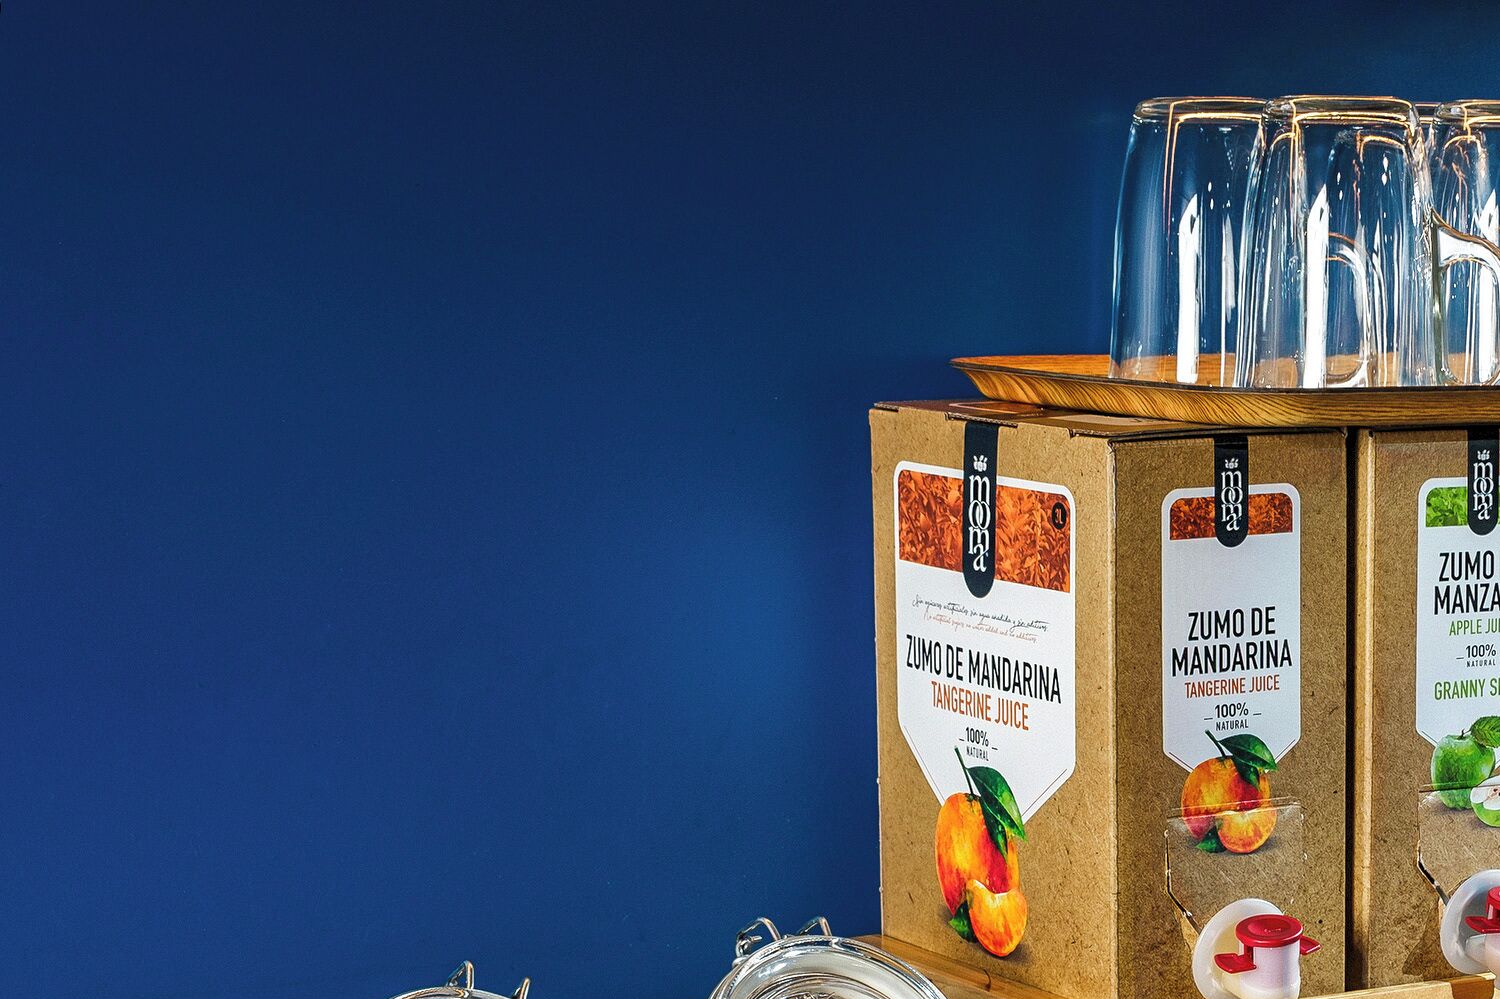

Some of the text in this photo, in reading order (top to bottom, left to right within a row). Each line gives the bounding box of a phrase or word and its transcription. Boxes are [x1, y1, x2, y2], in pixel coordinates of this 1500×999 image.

[1439, 550, 1494, 582] ZUMO
[1188, 606, 1276, 641] ZUMO DE
[1449, 618, 1482, 636] APPLE
[1171, 639, 1293, 678] MANDARINA
[1465, 644, 1497, 659] 100%
[906, 634, 1061, 704] ZUMO DE MANDARINA
[1466, 659, 1496, 668] NATURAL
[1185, 674, 1281, 699] TANGERINE JUICE
[1434, 679, 1486, 701] GRANNY
[931, 680, 1029, 731] TANGERINE JUICE
[1214, 703, 1249, 718] 100%
[965, 726, 989, 747] 100%
[1215, 720, 1249, 732] NATURAL
[966, 746, 989, 762] NATURAL
